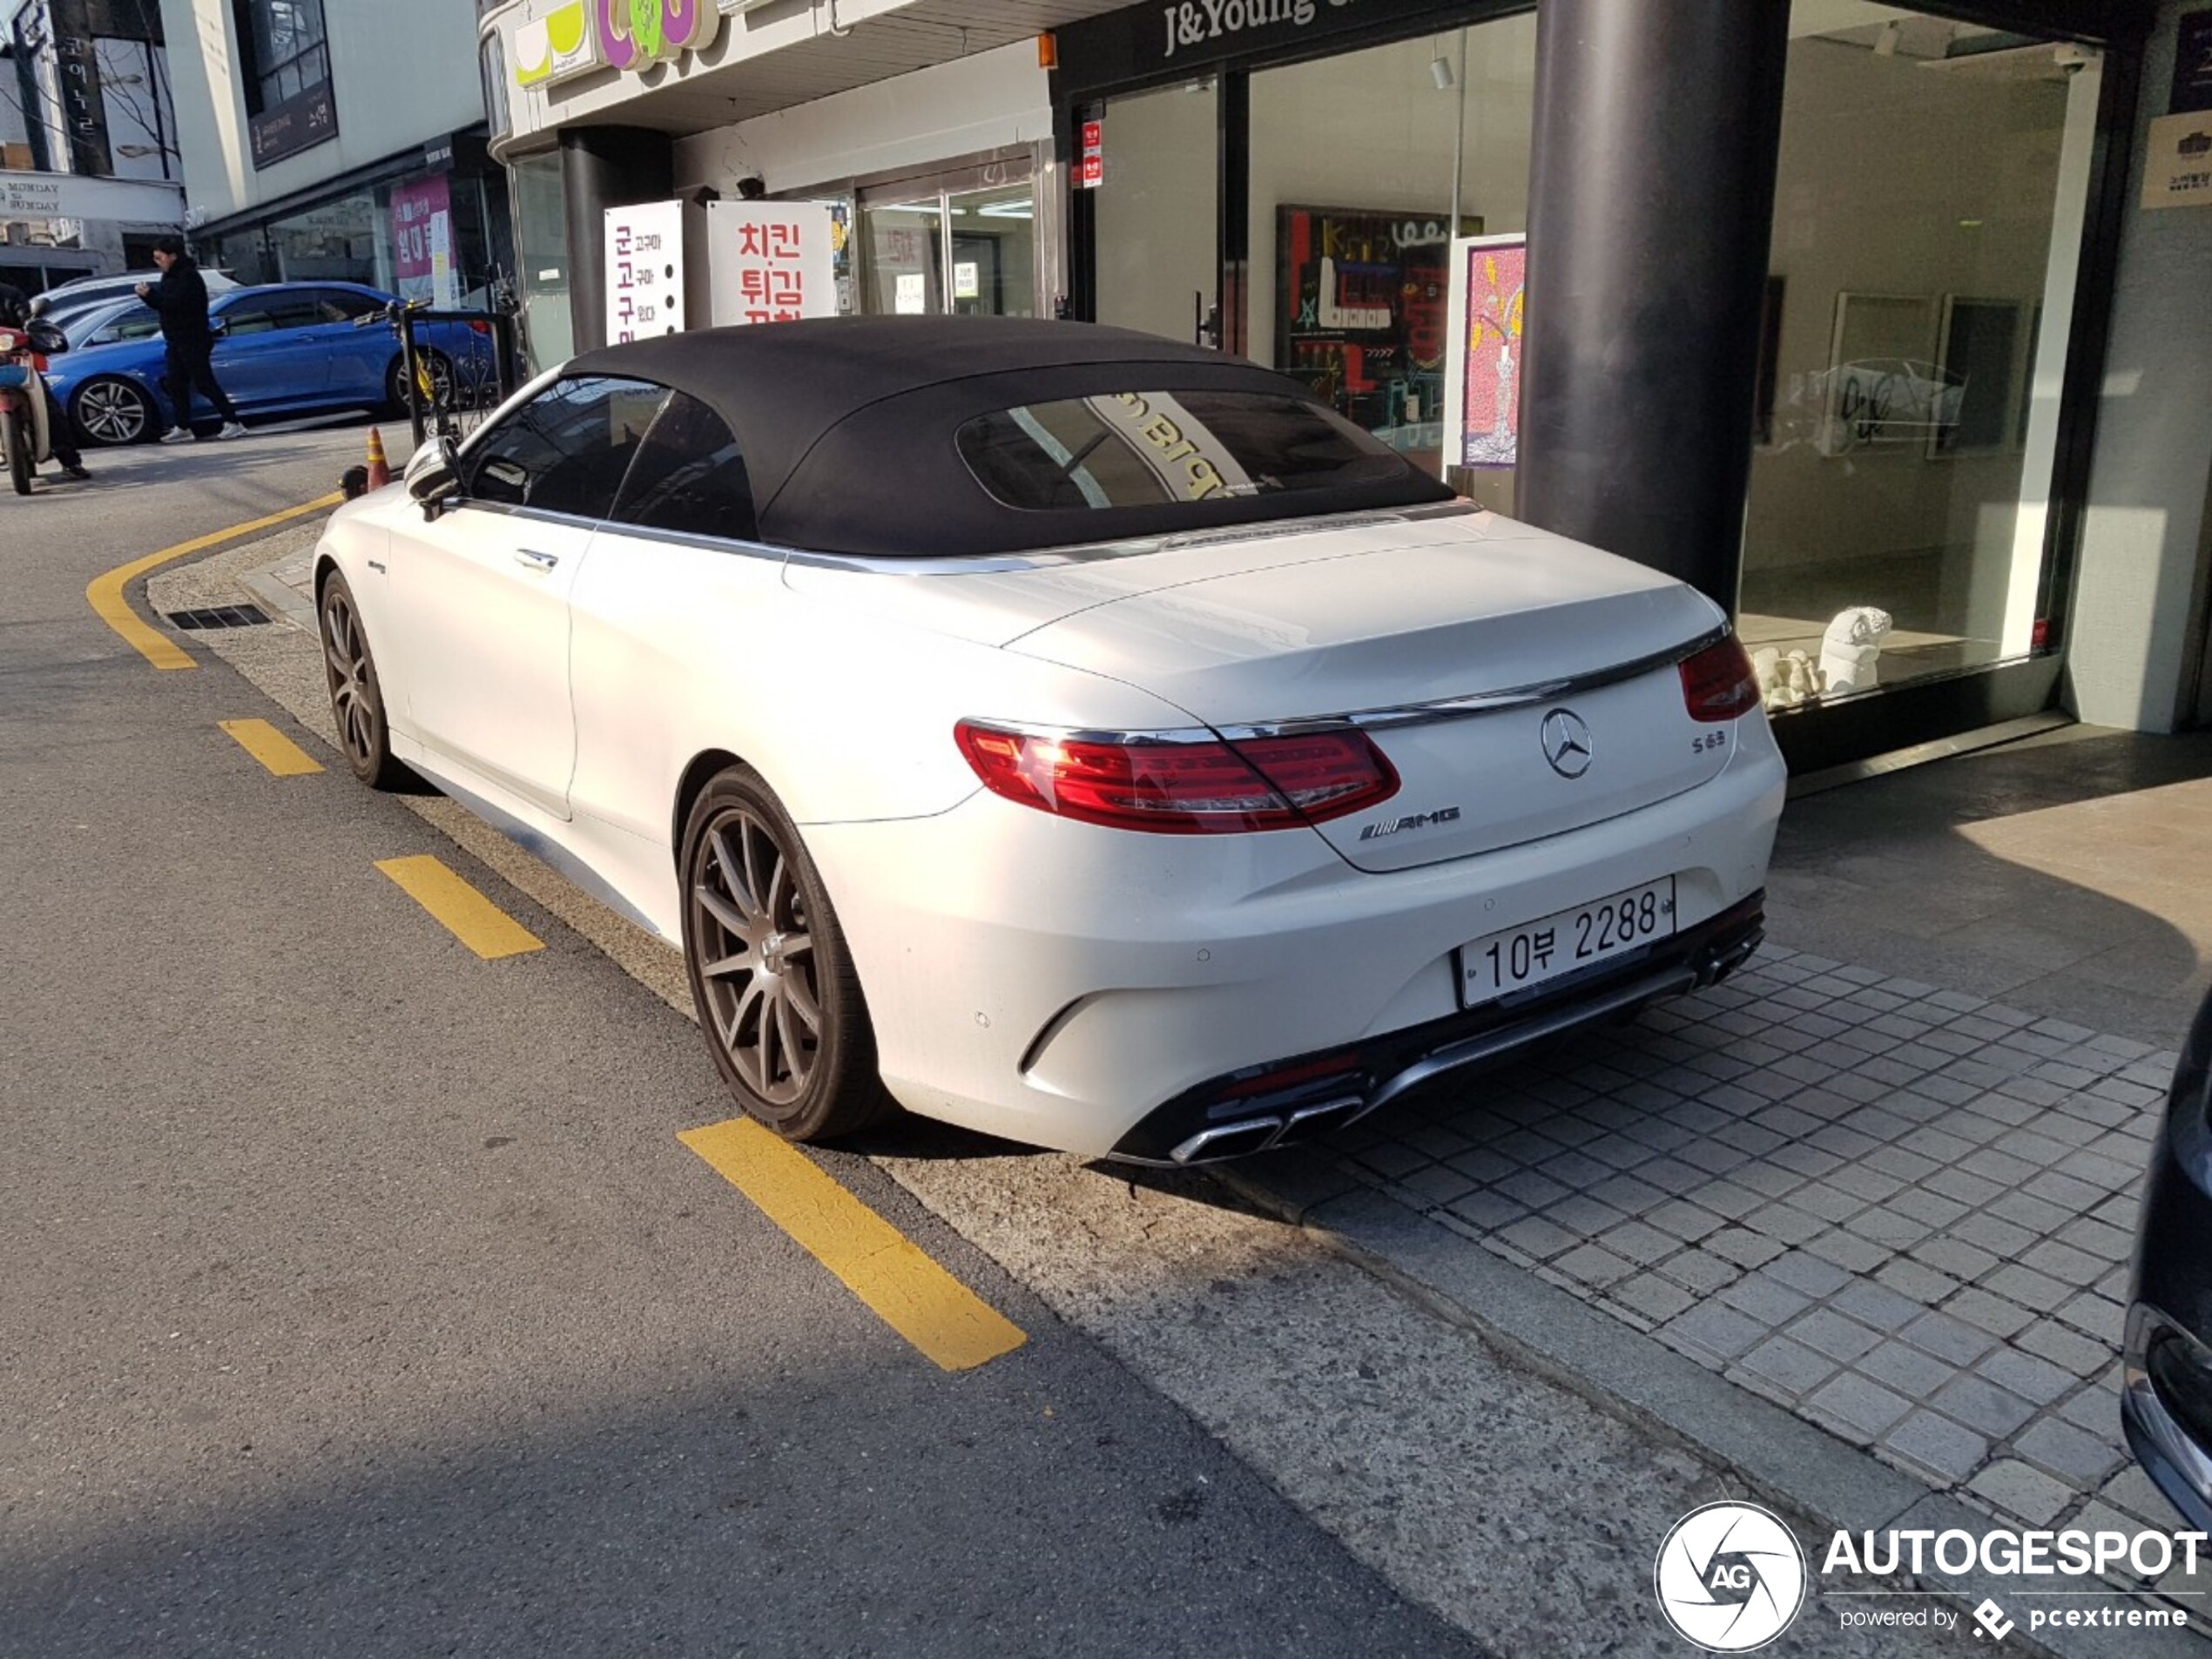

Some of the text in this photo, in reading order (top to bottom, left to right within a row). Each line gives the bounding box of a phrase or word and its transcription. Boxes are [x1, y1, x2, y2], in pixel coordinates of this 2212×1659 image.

[8, 182, 59, 195] MONDAY
[10, 199, 59, 211] SUNDAY
[738, 222, 801, 259] 치킨
[740, 269, 802, 307] 튀김
[1485, 891, 1656, 988] 10부 2288
